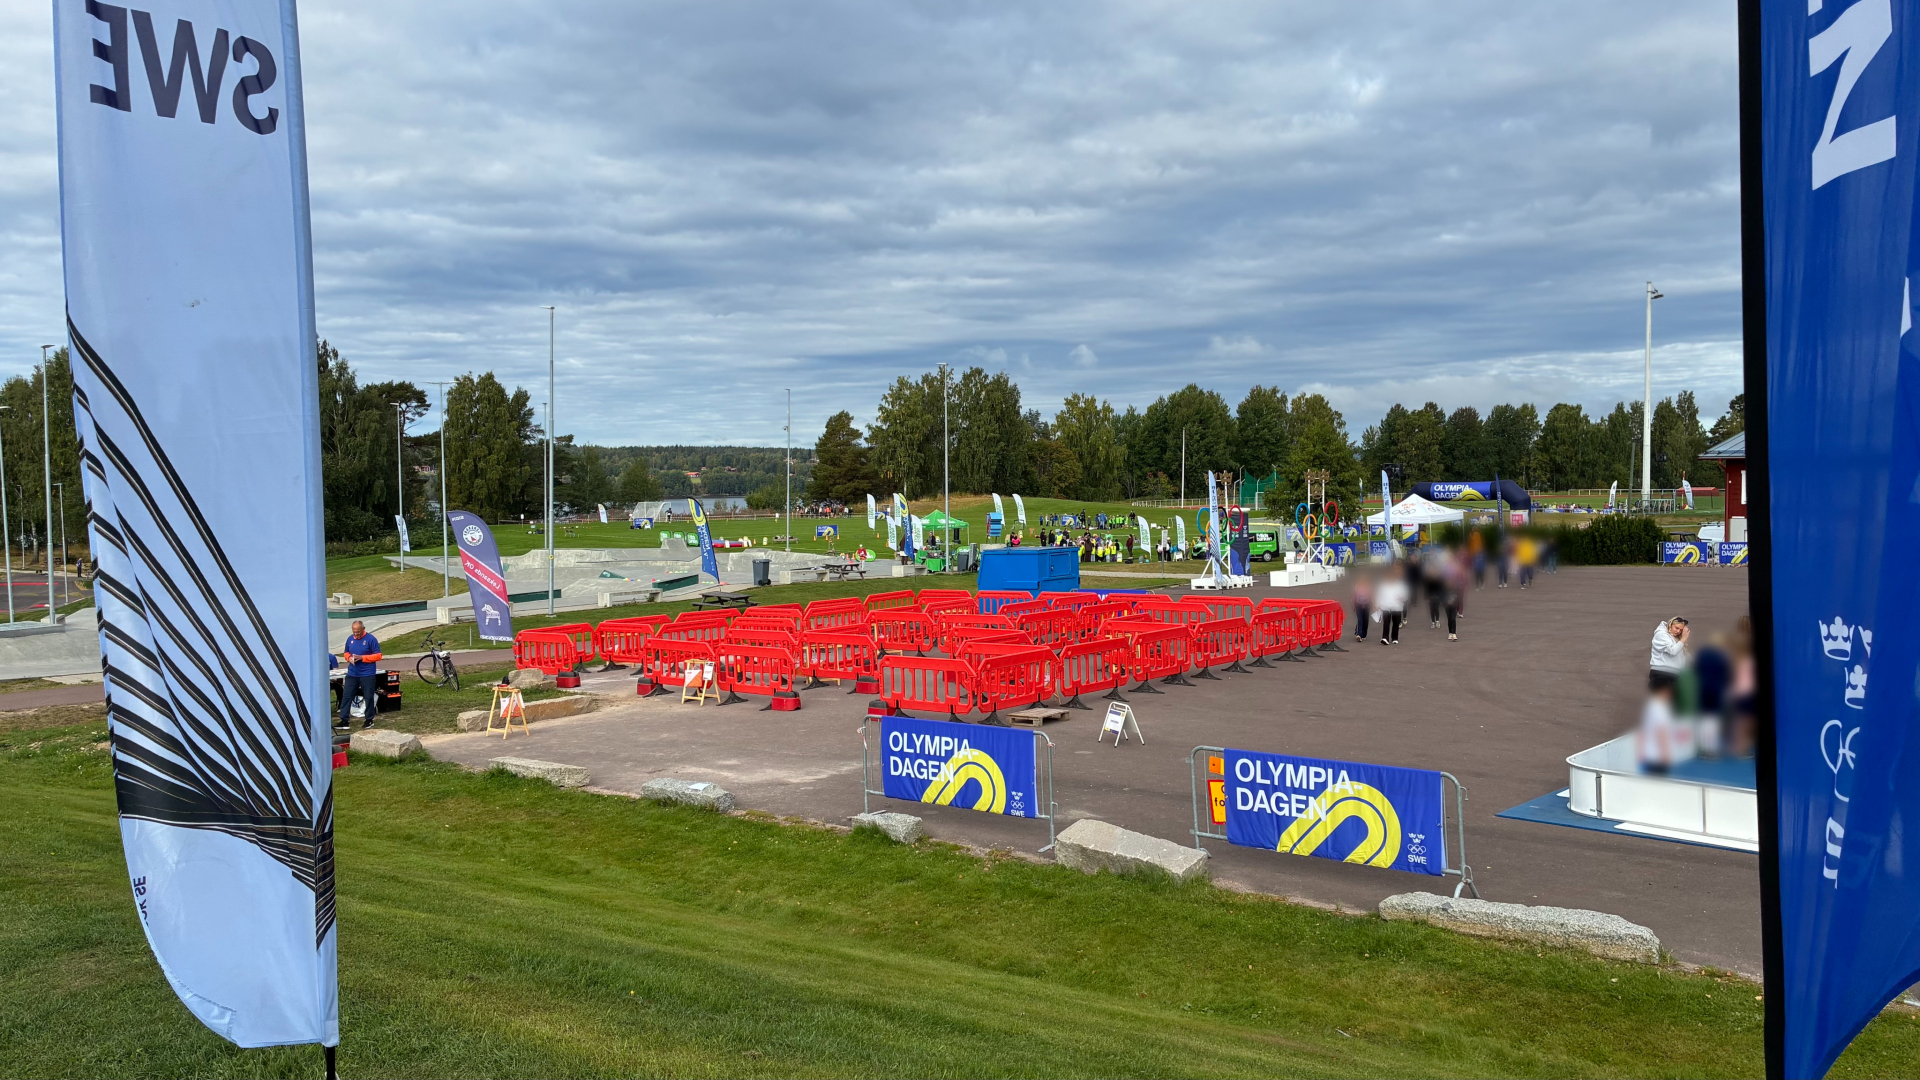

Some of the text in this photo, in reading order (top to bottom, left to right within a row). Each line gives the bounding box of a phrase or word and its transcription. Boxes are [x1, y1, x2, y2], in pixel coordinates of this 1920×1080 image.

[888, 731, 979, 760] OLYMPIA-
[889, 755, 954, 783] DAGEN
[1234, 758, 1363, 795] OLYMPIA-
[1010, 809, 1025, 818] SWE
[1236, 787, 1327, 821] DAGEN
[1407, 854, 1427, 865] SWE
